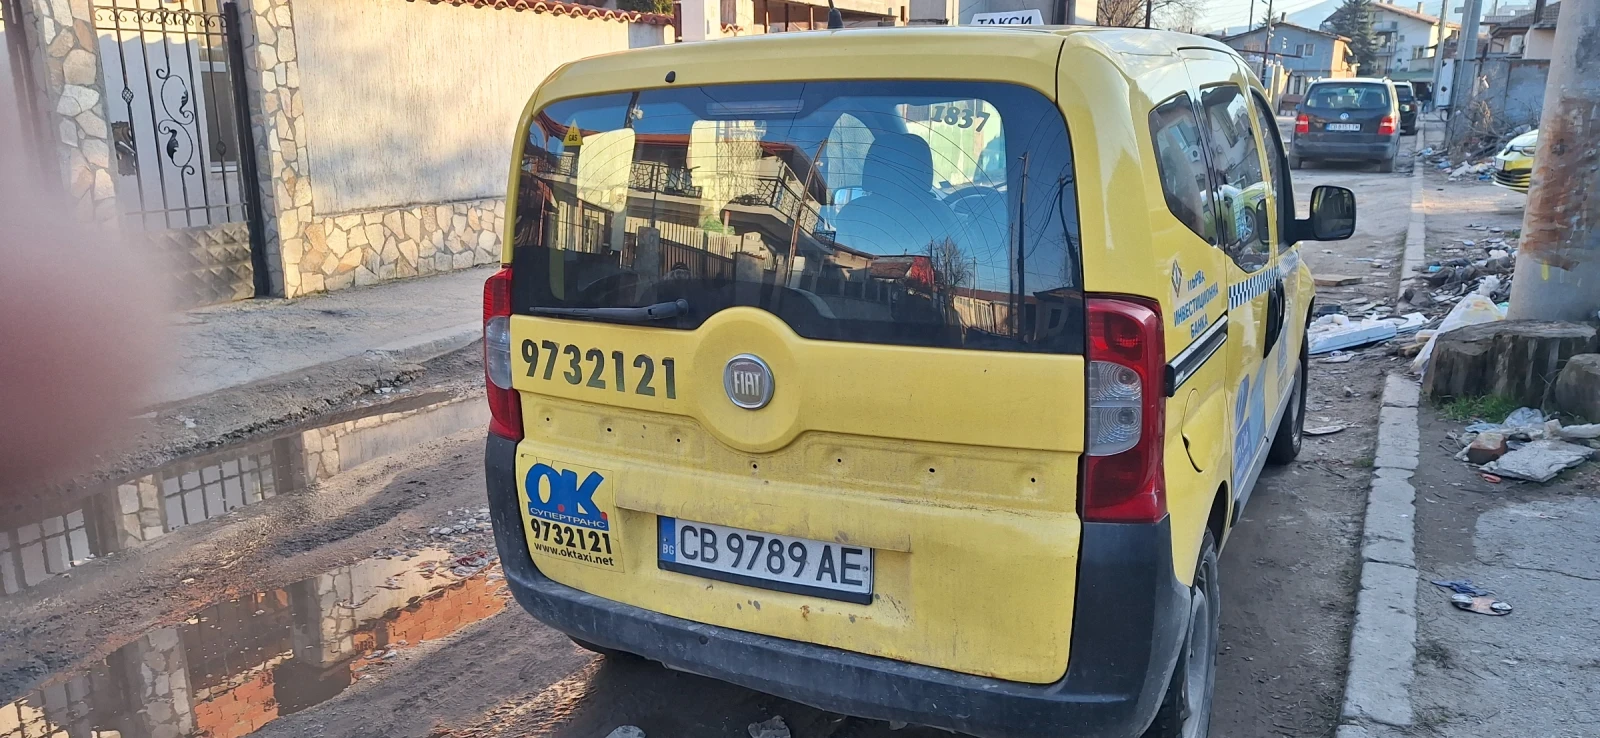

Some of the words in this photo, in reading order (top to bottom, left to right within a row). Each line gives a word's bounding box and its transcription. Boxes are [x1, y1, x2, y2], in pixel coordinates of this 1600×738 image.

[931, 105, 991, 132] 1837
[568, 134, 578, 142] GAS
[1190, 313, 1208, 339] БАНКА
[521, 338, 677, 399] 9732121
[733, 370, 761, 396] FIAT
[530, 507, 605, 528] СУПЕРТРАНС
[530, 518, 612, 554] 9732121
[662, 543, 674, 555] BG
[533, 542, 614, 566] www.oktaxi.net
[680, 525, 719, 563] CB
[726, 533, 808, 578] 9789
[815, 545, 863, 586] AE
